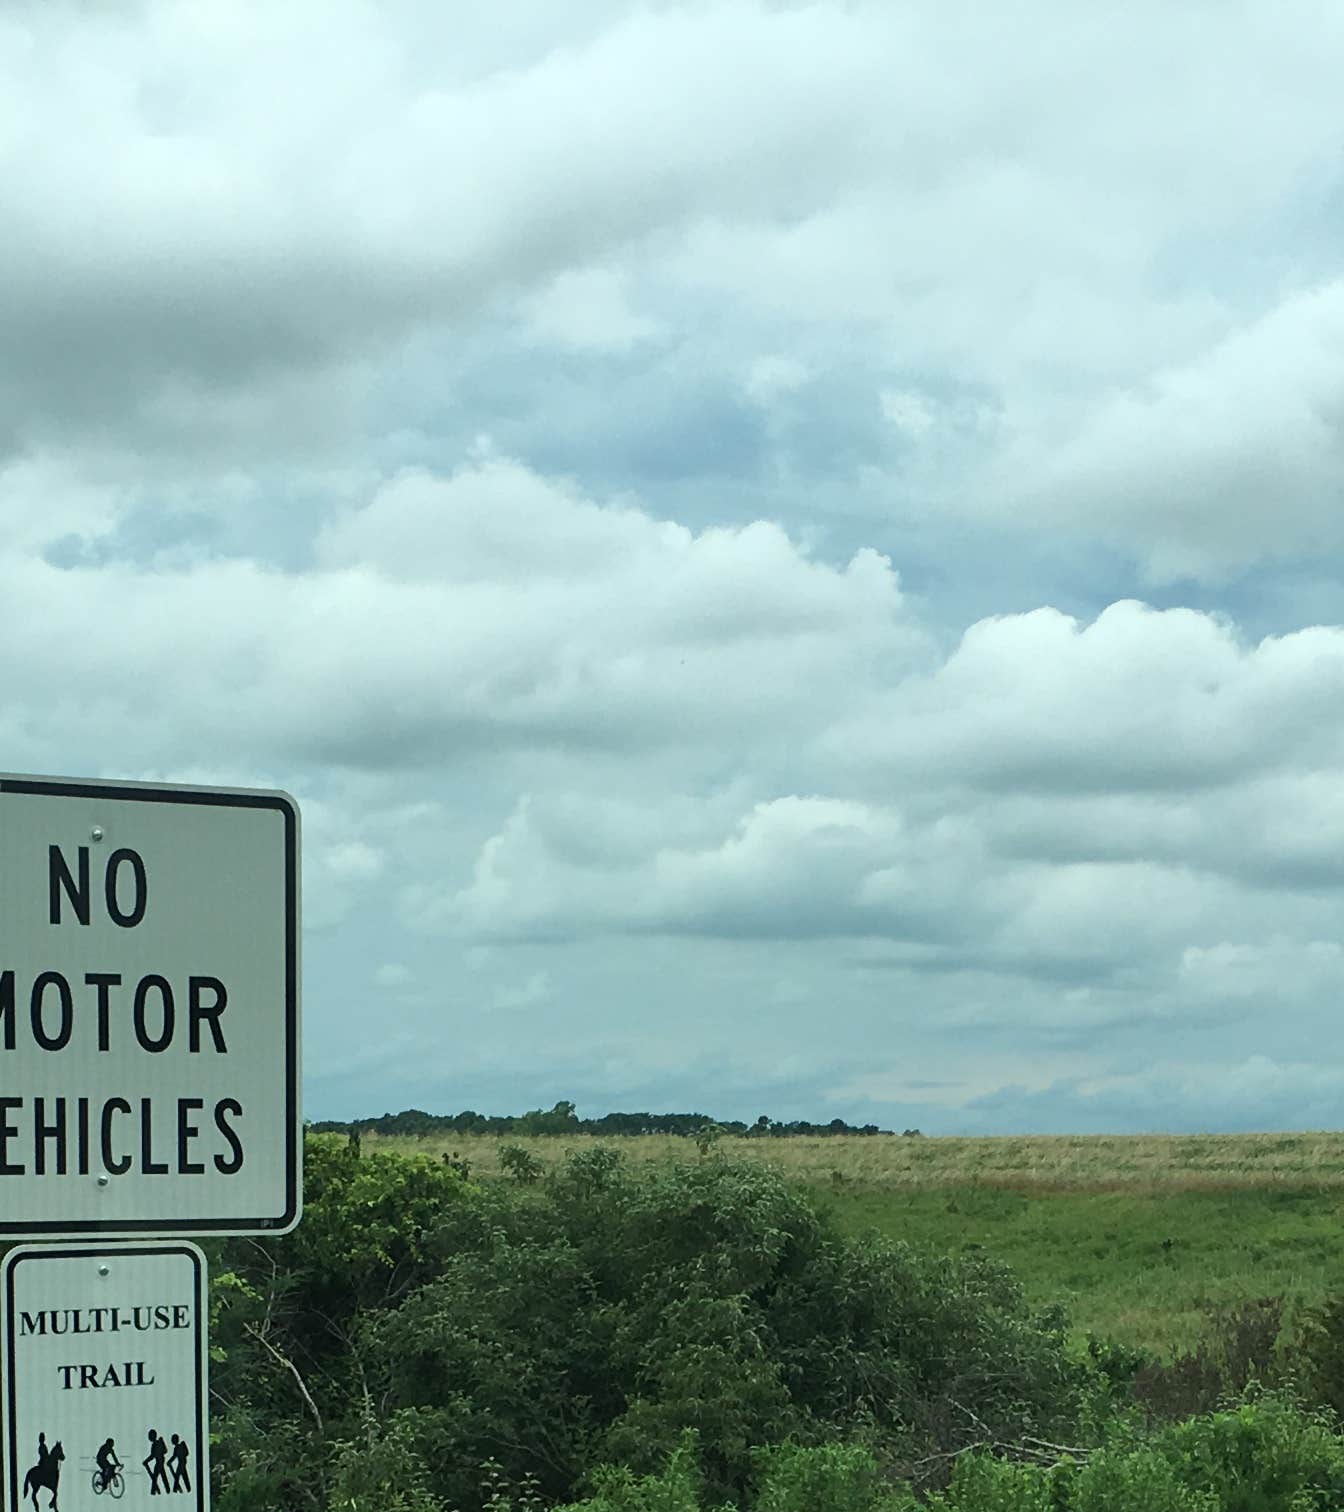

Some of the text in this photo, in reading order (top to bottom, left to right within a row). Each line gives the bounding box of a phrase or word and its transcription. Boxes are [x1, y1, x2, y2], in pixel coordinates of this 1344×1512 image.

[49, 845, 148, 928] NO
[19, 1305, 191, 1337] MULTI-USE
[58, 1362, 155, 1390] TRAIL
